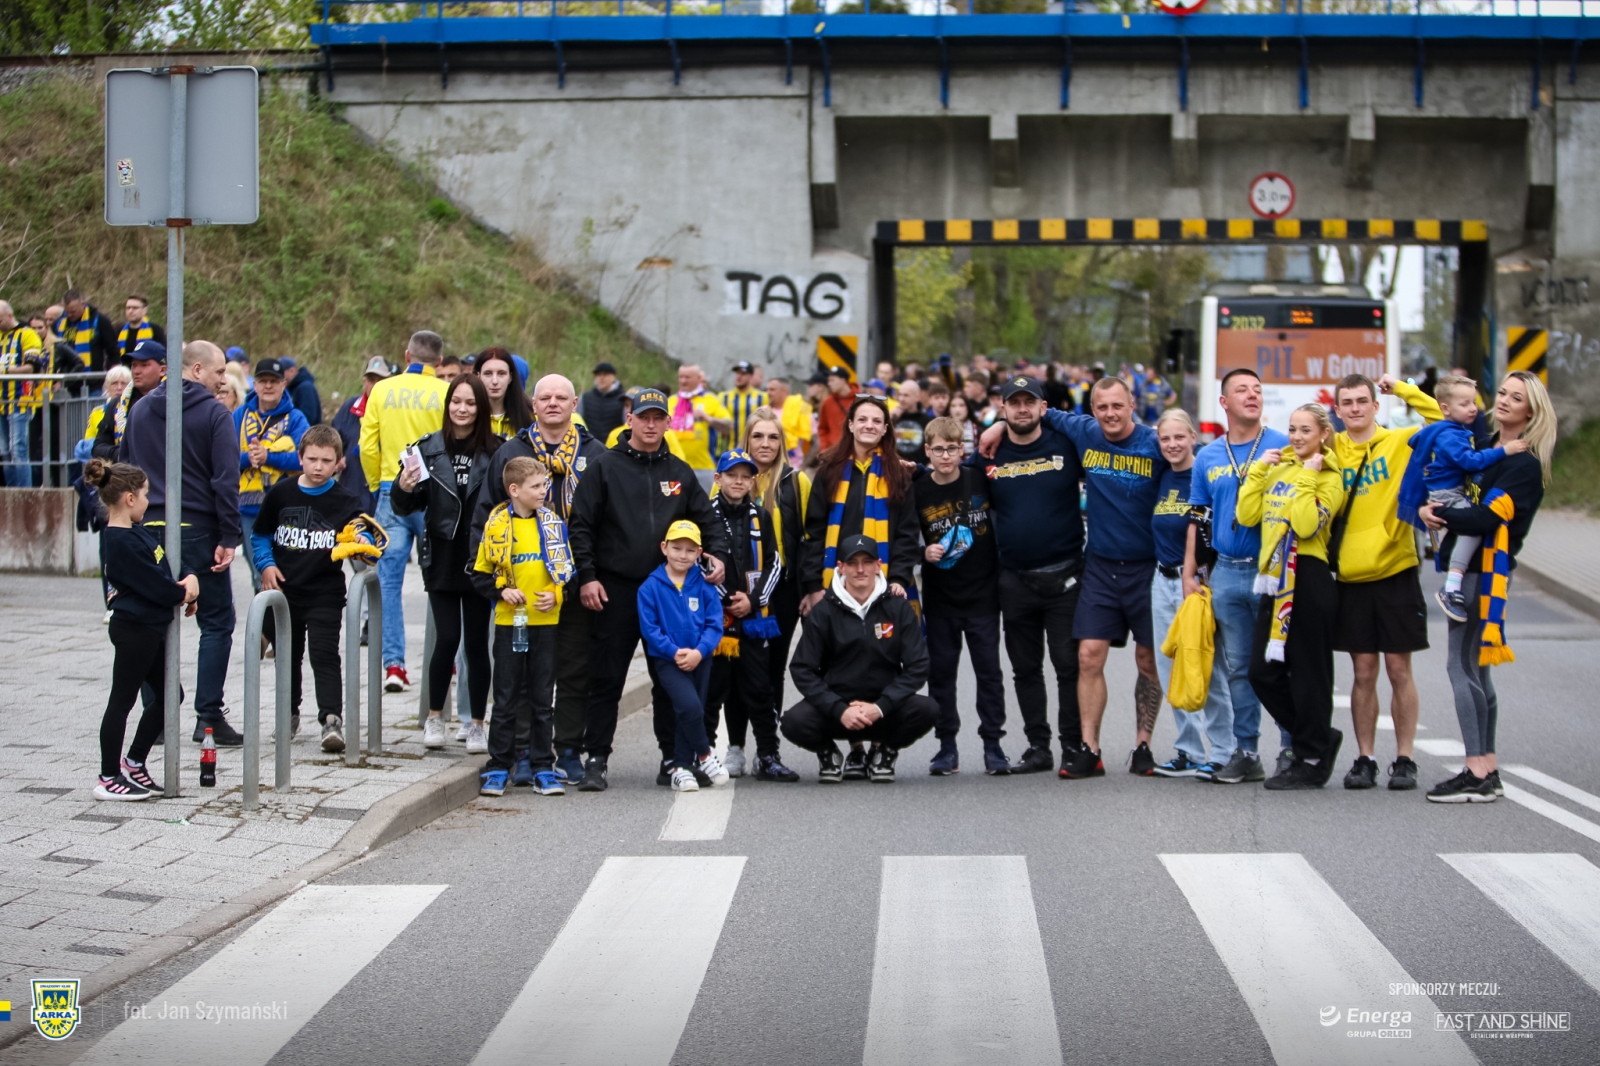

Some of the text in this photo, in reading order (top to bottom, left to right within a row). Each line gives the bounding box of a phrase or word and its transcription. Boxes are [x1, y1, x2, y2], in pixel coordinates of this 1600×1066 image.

[725, 270, 848, 320] TAG
[1231, 316, 1266, 331] 2032
[1307, 357, 1324, 379] w
[384, 388, 441, 411] ARKA
[640, 392, 664, 403] ARKA
[1083, 448, 1153, 478] ARKA GDYNIA
[1339, 456, 1390, 491] RKA
[955, 511, 988, 524] YNIA
[511, 553, 542, 565] GDYN
